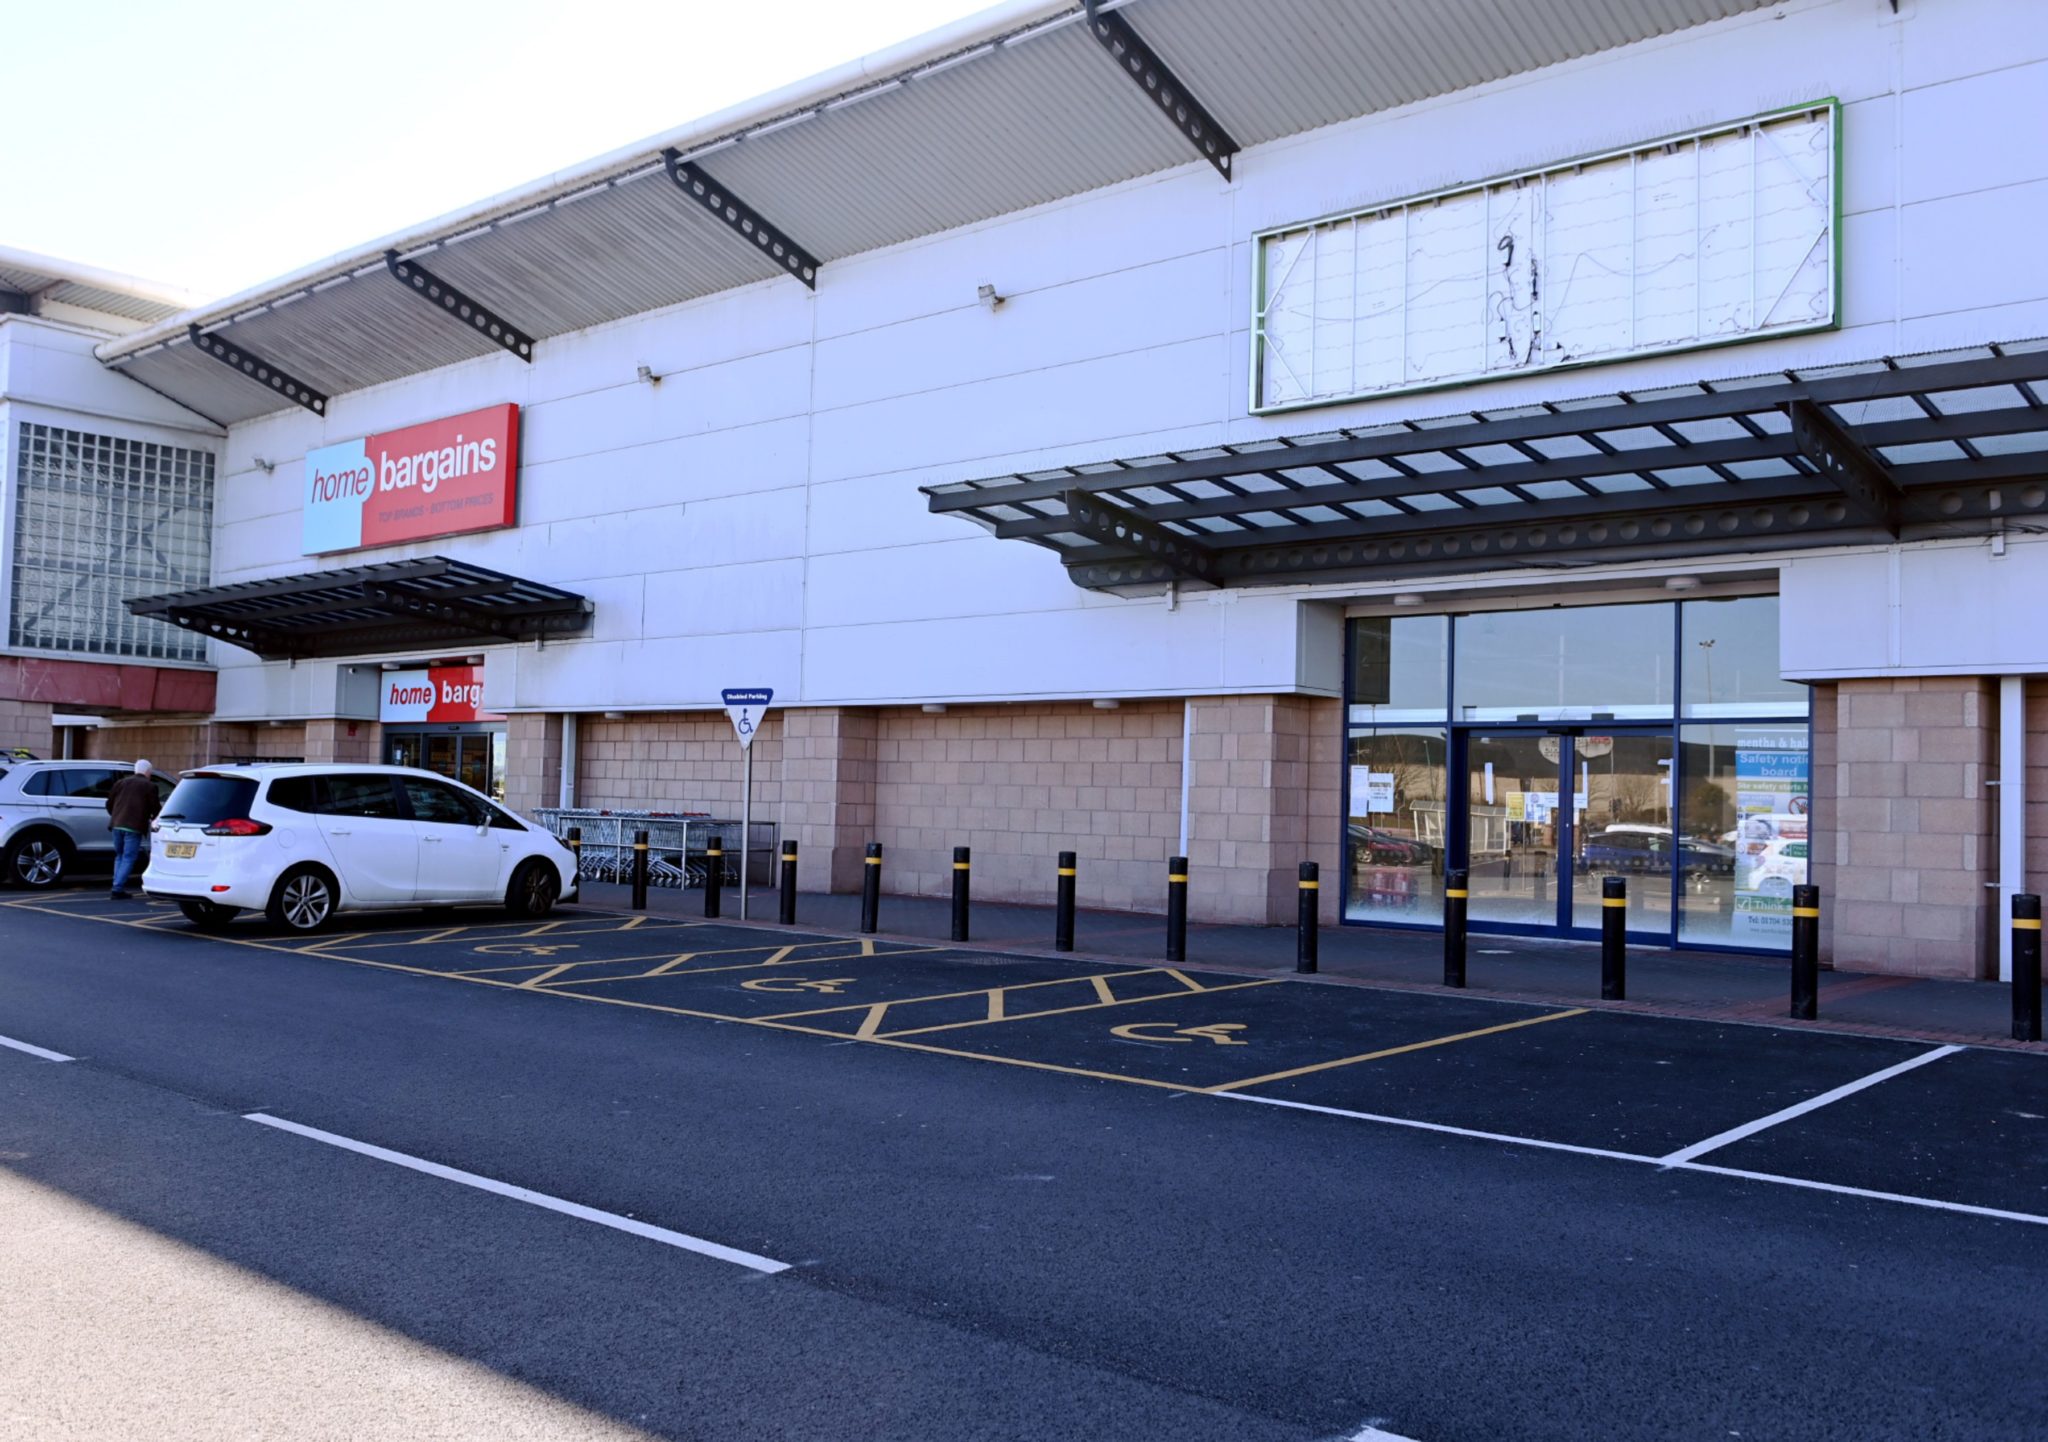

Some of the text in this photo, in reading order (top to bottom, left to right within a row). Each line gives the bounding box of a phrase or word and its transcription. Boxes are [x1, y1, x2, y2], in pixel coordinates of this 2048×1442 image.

[311, 434, 496, 504] home bargains
[378, 492, 494, 523] TOP BRANDS BOTTOM PRICES
[389, 683, 432, 705] home
[1778, 737, 1788, 748] &
[1740, 753, 1778, 765] Safety
[1761, 766, 1797, 776] board
[1754, 901, 1783, 910] Think
